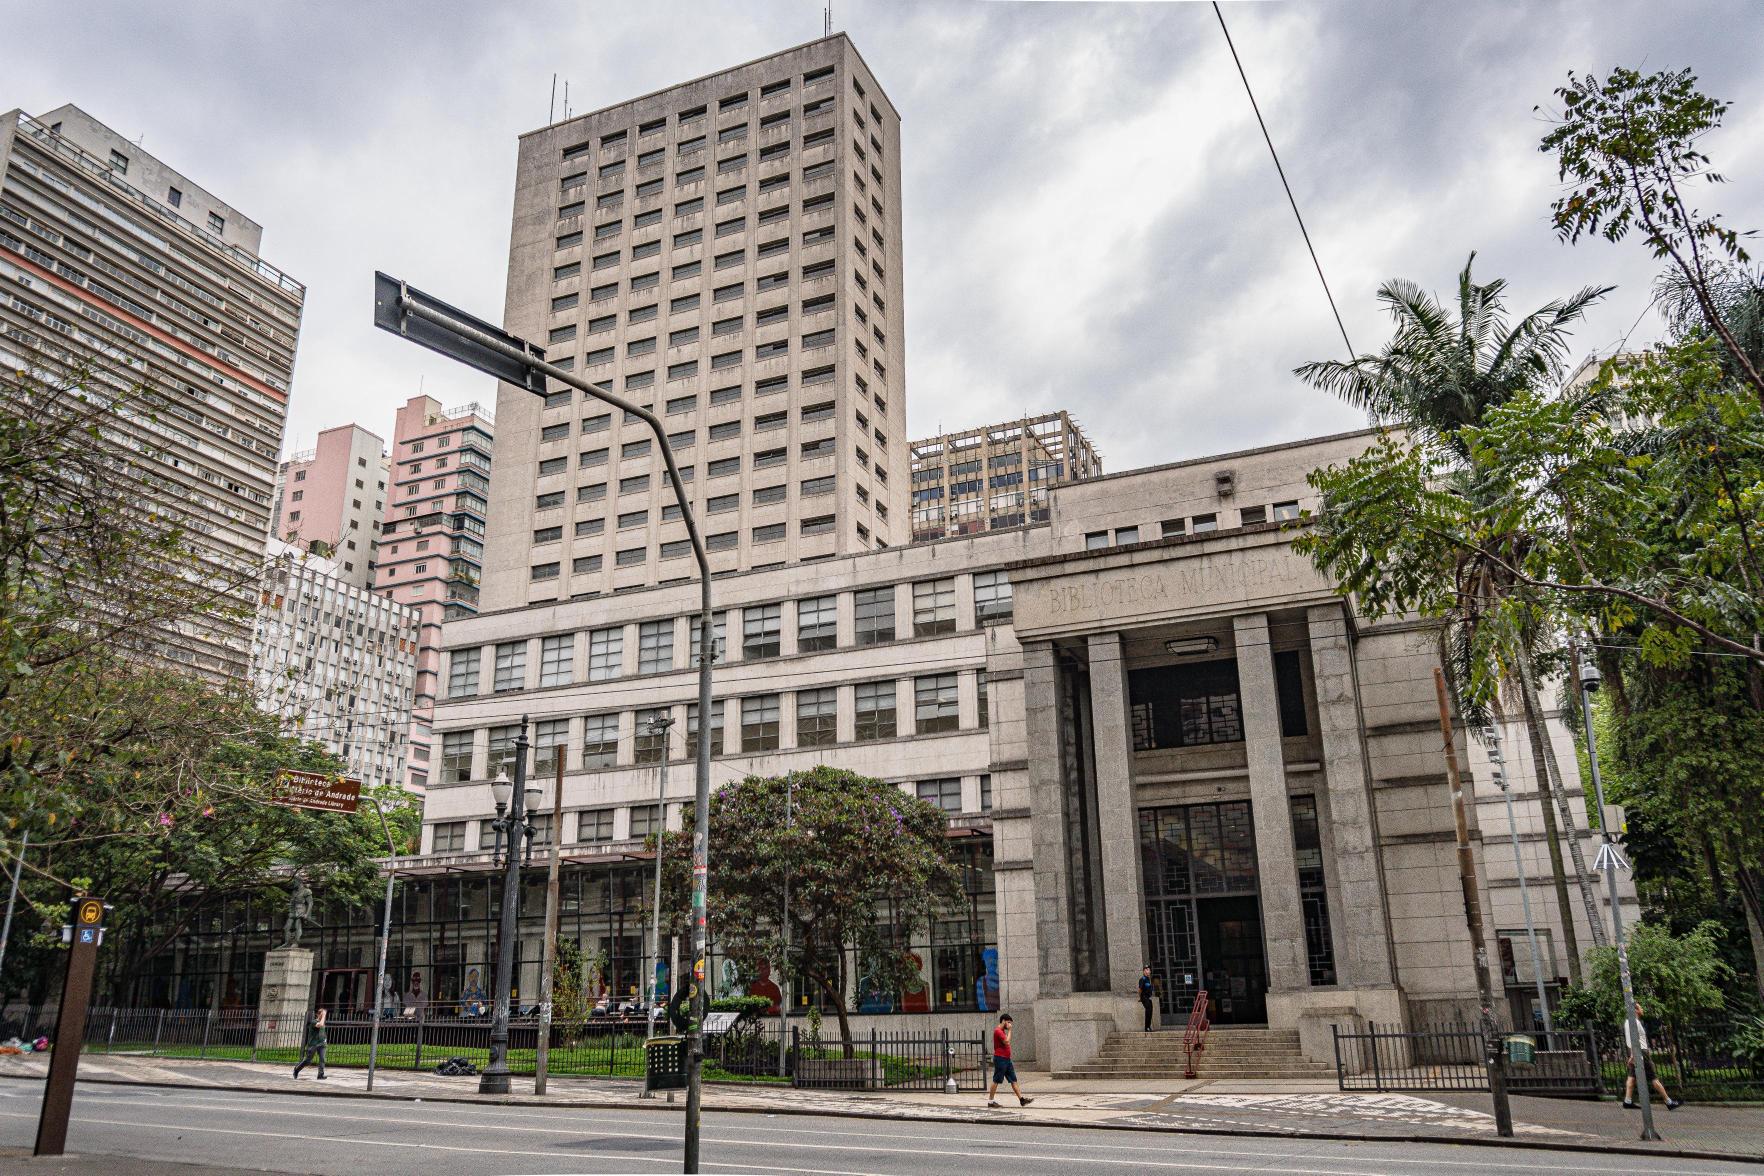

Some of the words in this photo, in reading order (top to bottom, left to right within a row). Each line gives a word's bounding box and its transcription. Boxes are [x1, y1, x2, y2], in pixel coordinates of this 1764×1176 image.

[1049, 575, 1169, 614] BIBLIOTECA
[1180, 556, 1298, 595] MUNICIPAL
[293, 776, 331, 788] Biblioteca
[326, 791, 356, 801] Andrade
[328, 801, 344, 809] Library
